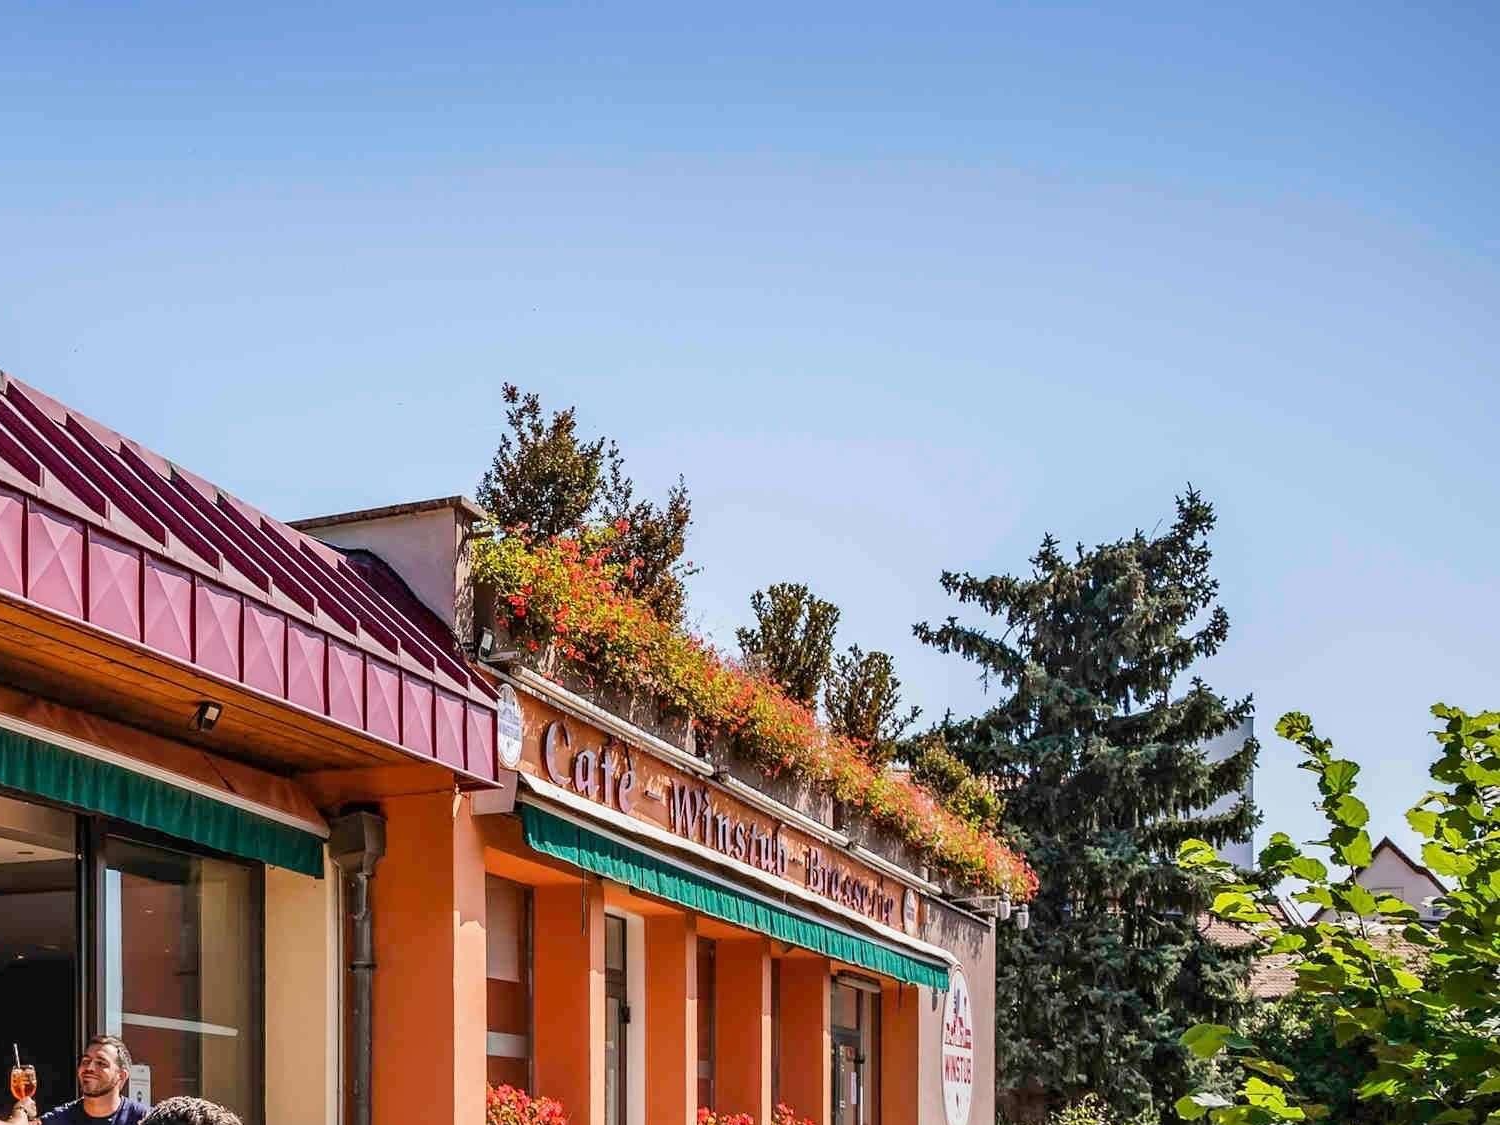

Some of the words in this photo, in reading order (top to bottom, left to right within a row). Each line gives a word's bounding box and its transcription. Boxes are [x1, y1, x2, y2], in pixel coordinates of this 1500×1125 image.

[542, 719, 636, 815] Café
[670, 778, 789, 878] Winstub
[944, 1053, 972, 1085] WINSTUB
